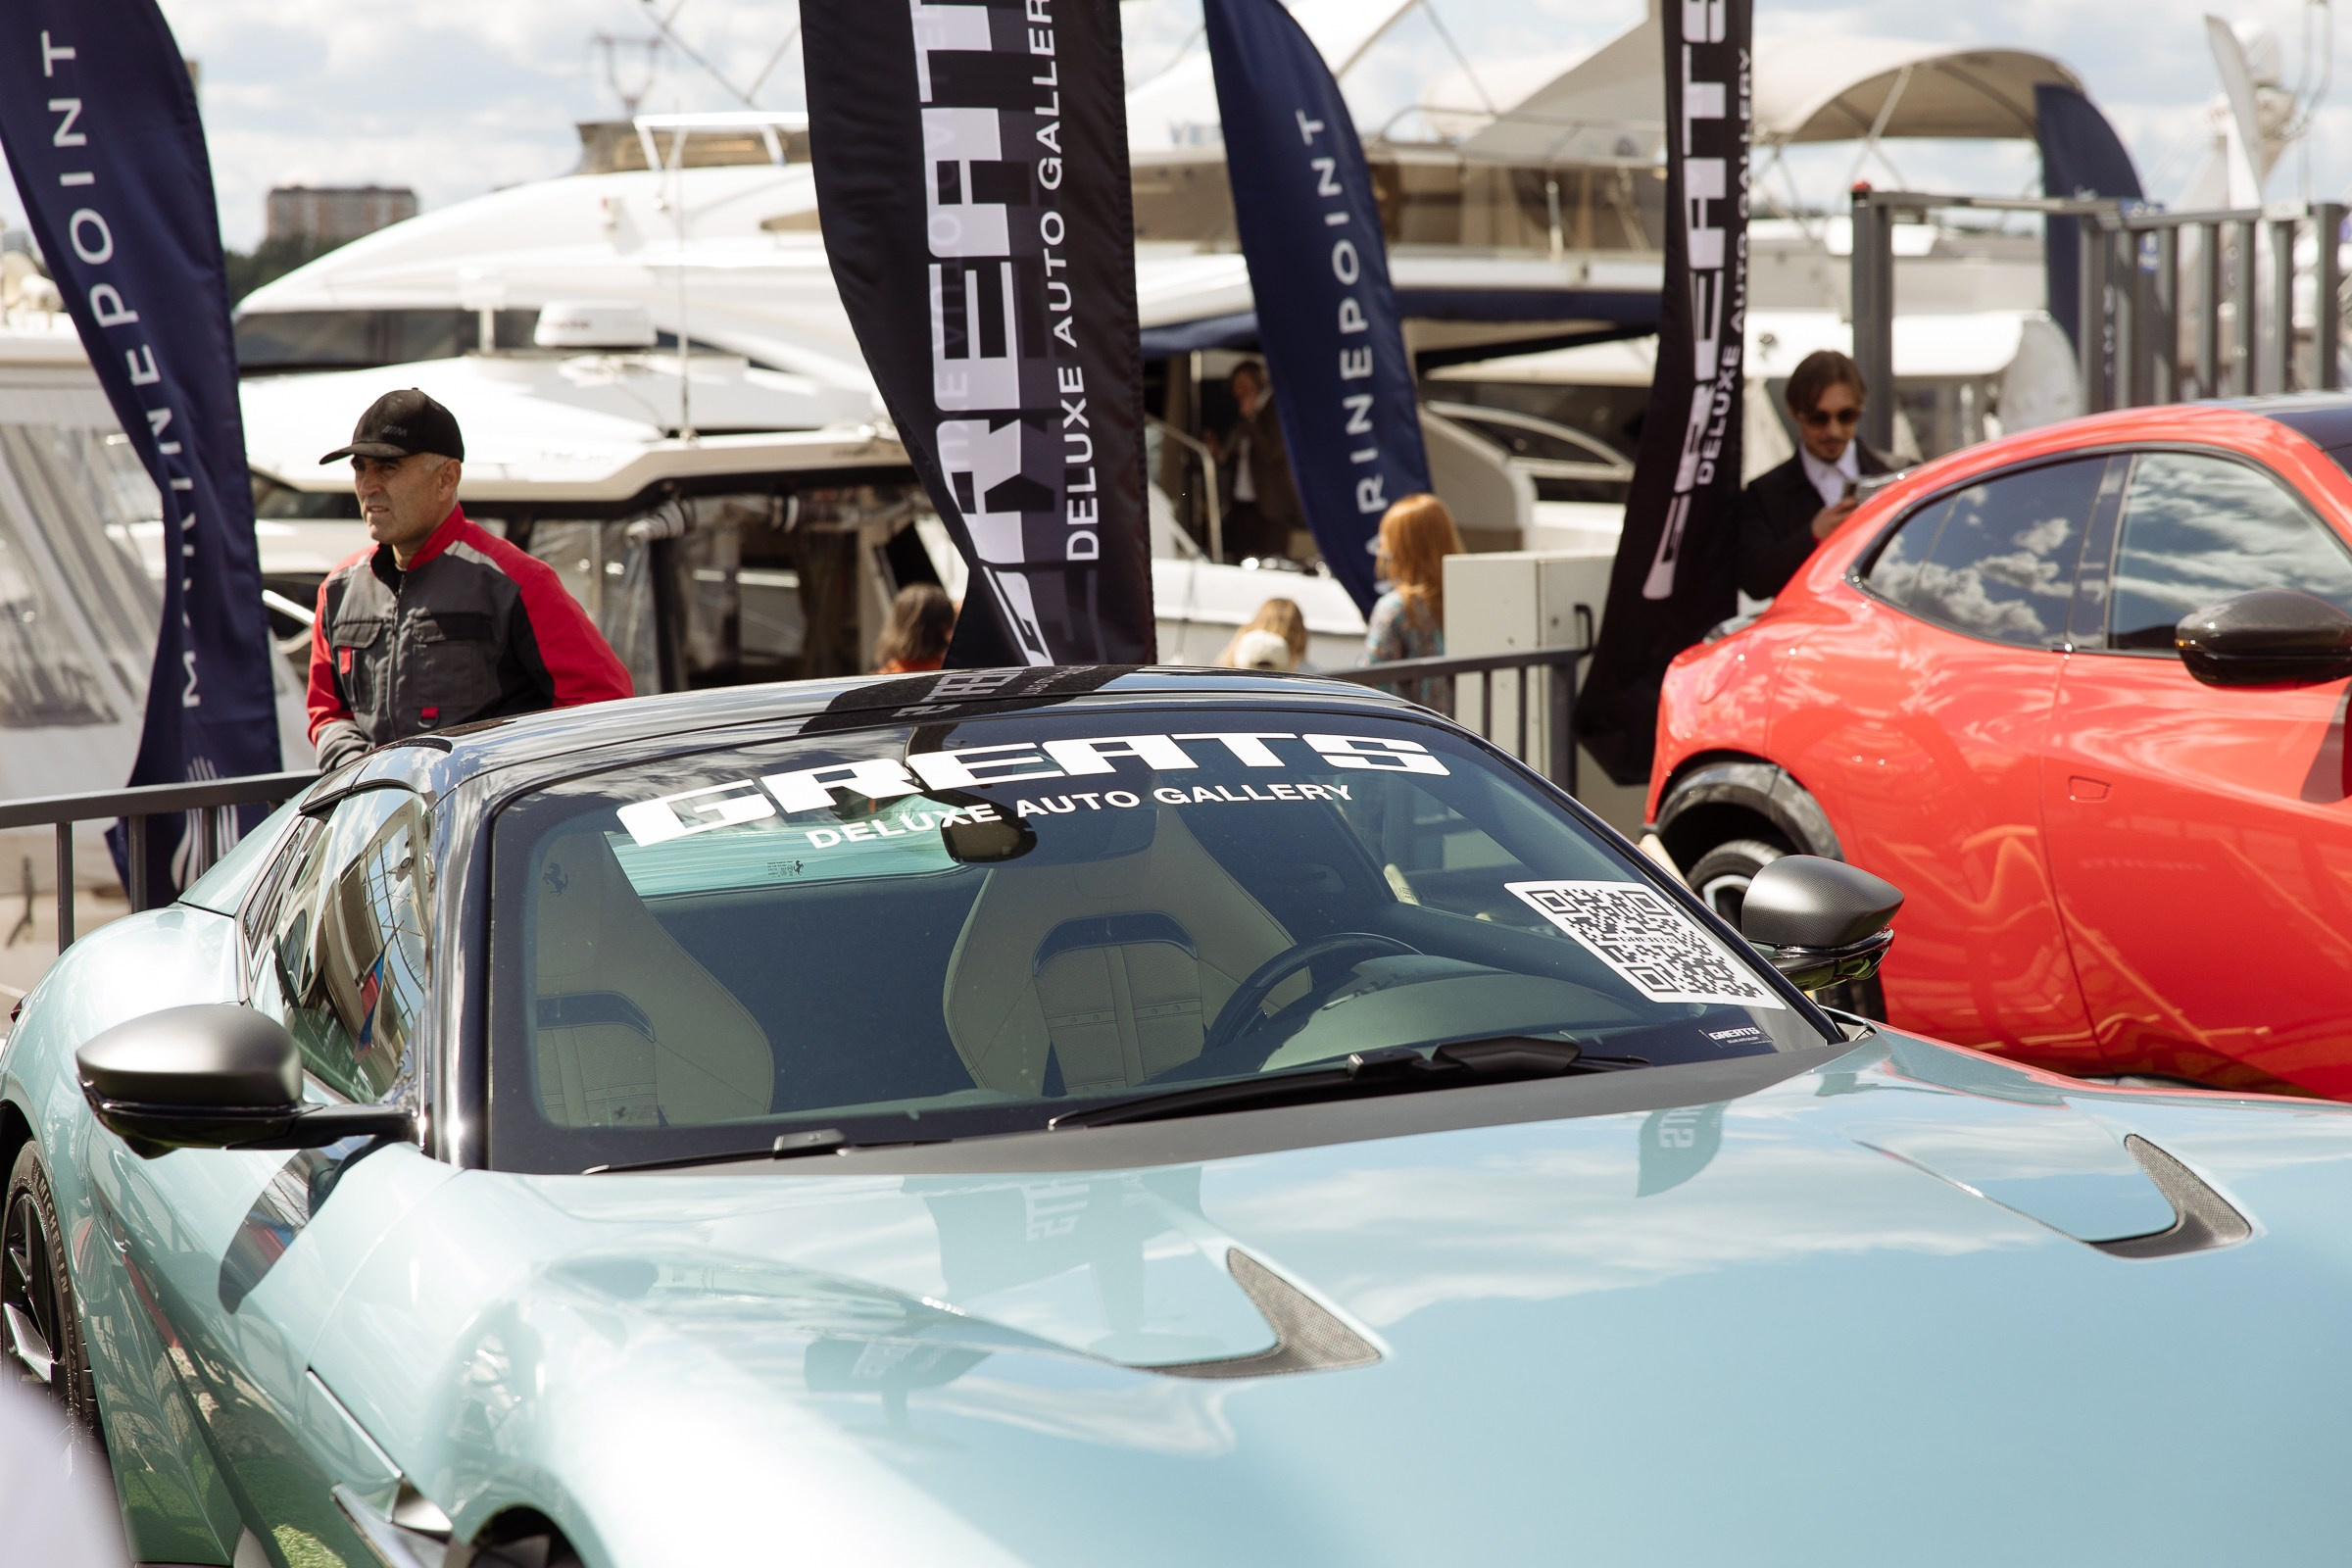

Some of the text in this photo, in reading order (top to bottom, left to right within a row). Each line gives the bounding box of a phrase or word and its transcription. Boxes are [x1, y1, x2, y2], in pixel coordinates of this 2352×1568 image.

[909, 0, 1054, 667] GREAT
[1026, 0, 1099, 562] DELUXE AUTO GALLER
[41, 30, 201, 709] MINEPOINT
[1696, 345, 1740, 484] DELUXE
[615, 733, 1450, 848] GREATS
[805, 784, 1353, 849] DELUXE AUTO GALLERY
[1708, 1027, 1761, 1041] GREATS
[38, 1177, 69, 1295] MICHELIN
